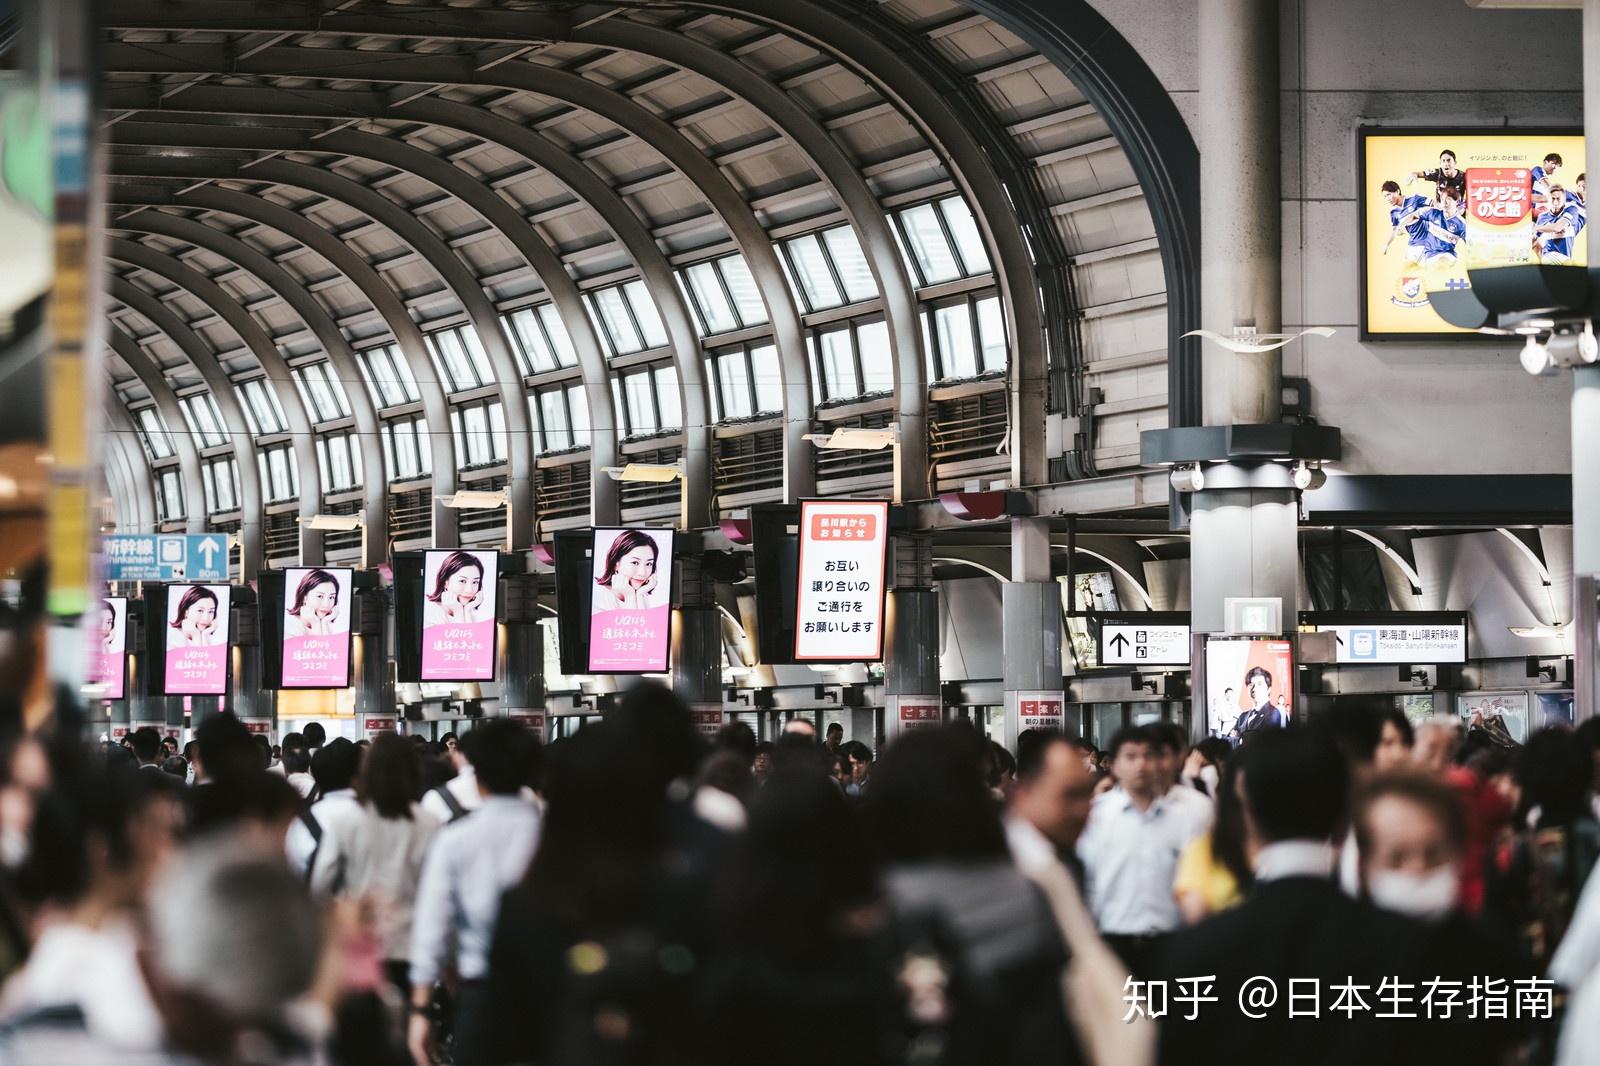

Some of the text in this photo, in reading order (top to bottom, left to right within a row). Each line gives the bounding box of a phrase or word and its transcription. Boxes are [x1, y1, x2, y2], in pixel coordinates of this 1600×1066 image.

[1477, 202, 1521, 218] のど飴
[820, 528, 866, 538] お知らせ
[824, 561, 860, 572] お互い
[812, 580, 870, 592] 譲り合いの
[817, 601, 863, 612] ご通行を
[804, 621, 874, 633] お願いします
[1379, 629, 1459, 641] 東海道・山陽新幹線
